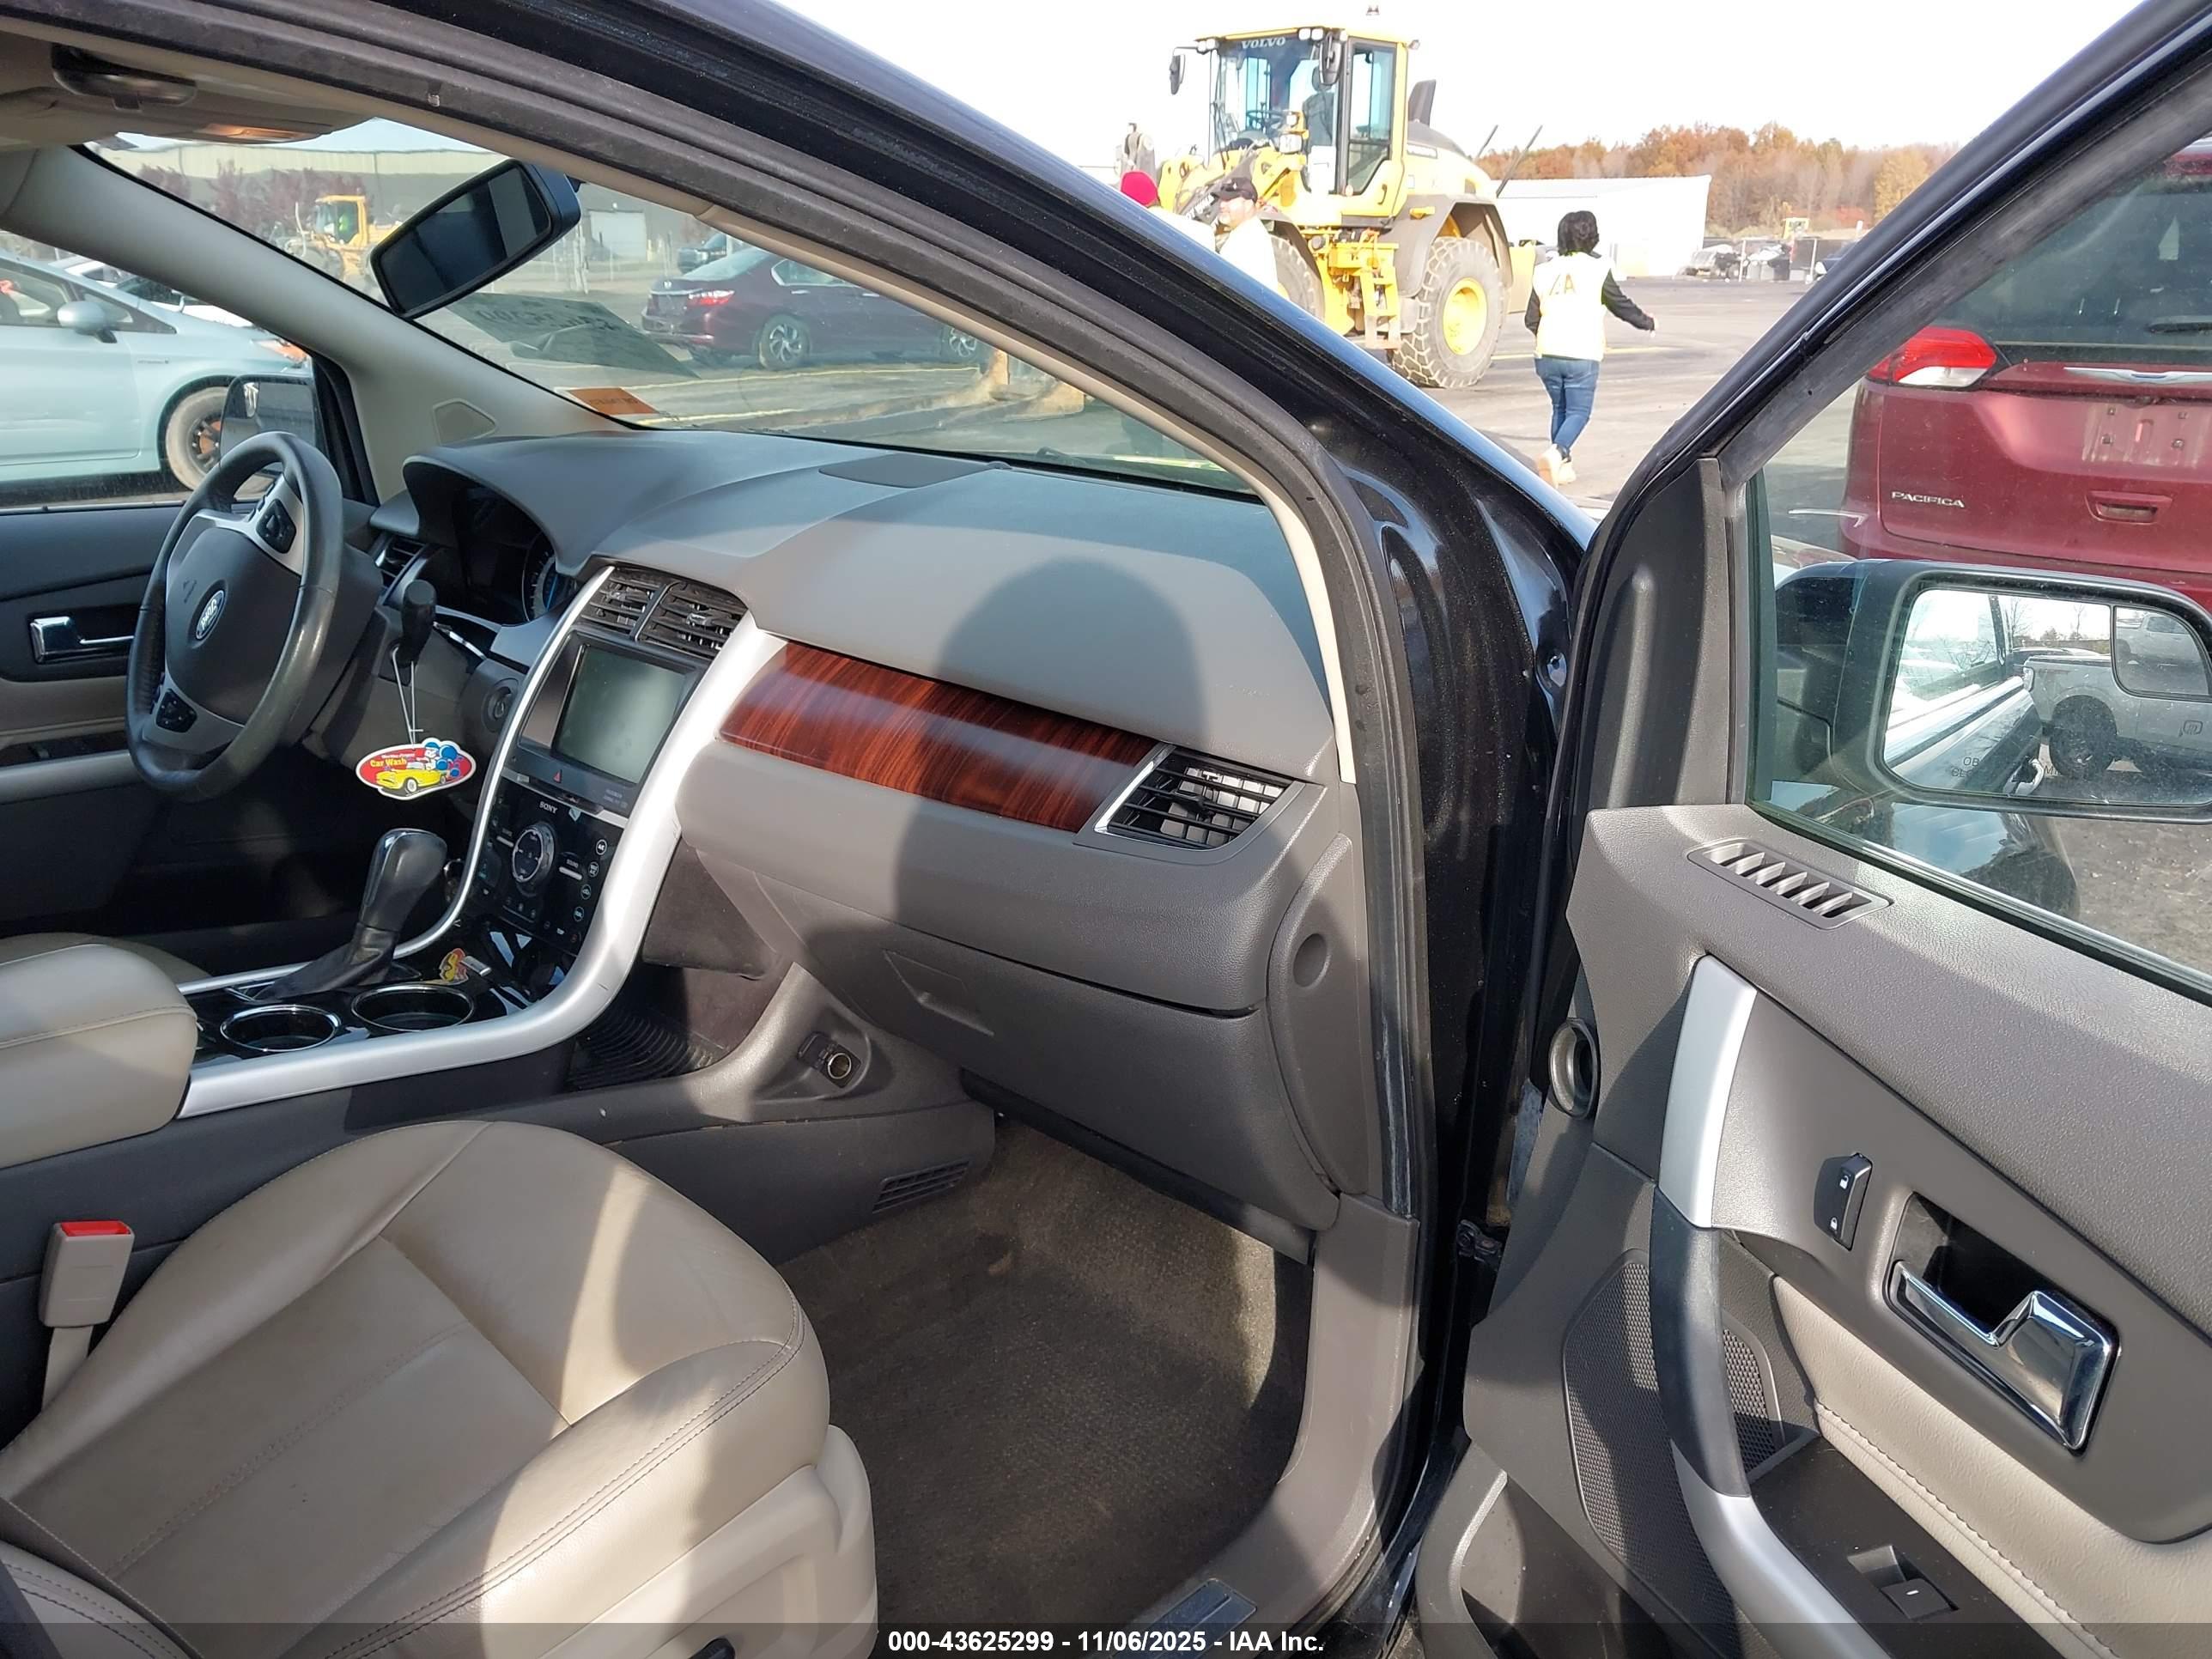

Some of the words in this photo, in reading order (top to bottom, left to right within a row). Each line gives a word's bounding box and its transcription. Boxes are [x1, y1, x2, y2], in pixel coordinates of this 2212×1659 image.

[1241, 36, 1286, 49] VOLVO
[1891, 490, 1966, 508] PACIFICA
[370, 759, 384, 768] Car
[385, 757, 408, 767] Wash
[538, 800, 558, 814] SONY
